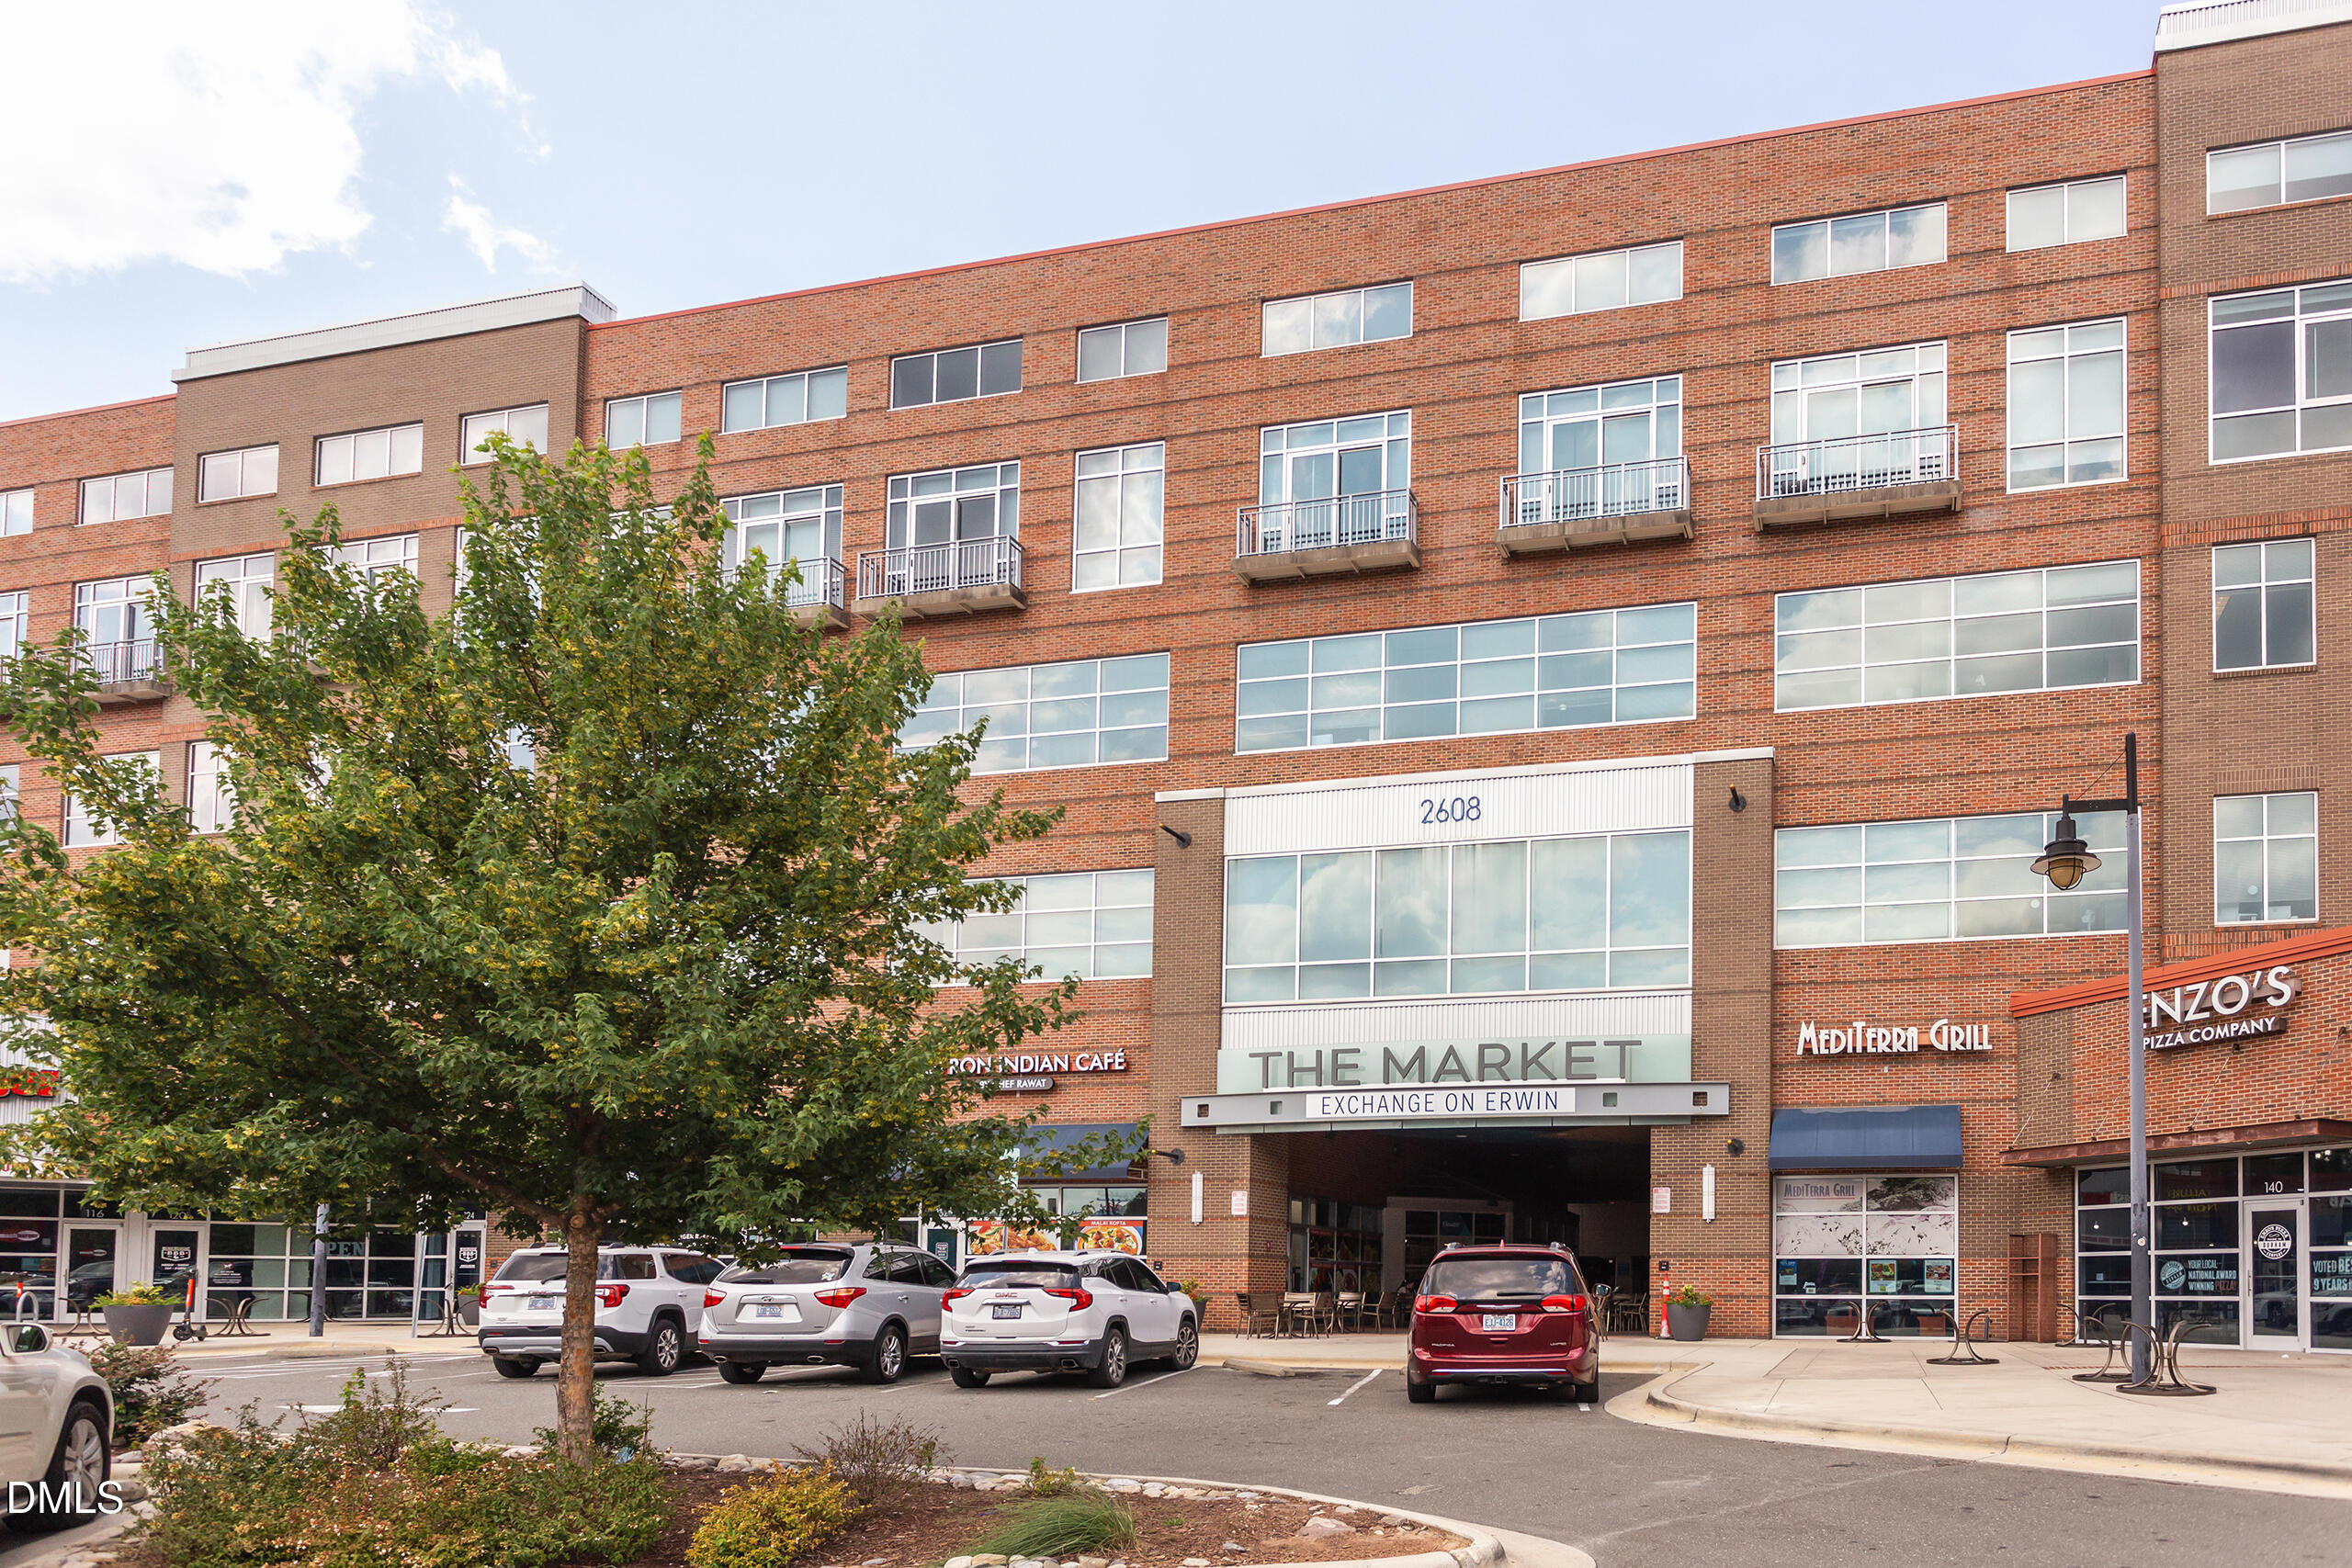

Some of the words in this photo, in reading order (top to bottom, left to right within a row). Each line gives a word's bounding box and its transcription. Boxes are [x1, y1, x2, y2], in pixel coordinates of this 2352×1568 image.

[1420, 796, 1482, 825] 2608
[2143, 965, 2291, 1030] NZO'S
[2143, 1031, 2185, 1050] PIZZA
[2189, 1016, 2276, 1043] COMPANY
[946, 1055, 991, 1075] RON
[1075, 1048, 1125, 1072] CAFÉ
[1249, 1047, 1363, 1089] THE
[1383, 1040, 1643, 1085] MARKET
[998, 1079, 1015, 1089] HEF
[1017, 1078, 1046, 1089] RAWAT
[1321, 1094, 1435, 1117] EXCHANGE
[1444, 1093, 1475, 1112] ON
[1485, 1090, 1559, 1112] ERWIN
[2264, 1180, 2283, 1193] 140
[85, 1209, 105, 1218] 116
[463, 1211, 475, 1219] 24
[2188, 1259, 2201, 1269] YOUR
[2202, 1259, 2218, 1269] LOCAL
[2313, 1260, 2337, 1273] VOTED
[2339, 1258, 2352, 1272] BE
[2188, 1269, 2215, 1280] NATIONAL
[2216, 1269, 2237, 1280] AWARD
[2188, 1280, 2214, 1291] WINNING
[2214, 1280, 2237, 1291] PIZZA!
[2313, 1278, 2320, 1291] 9
[2321, 1278, 2347, 1292] YEARS
